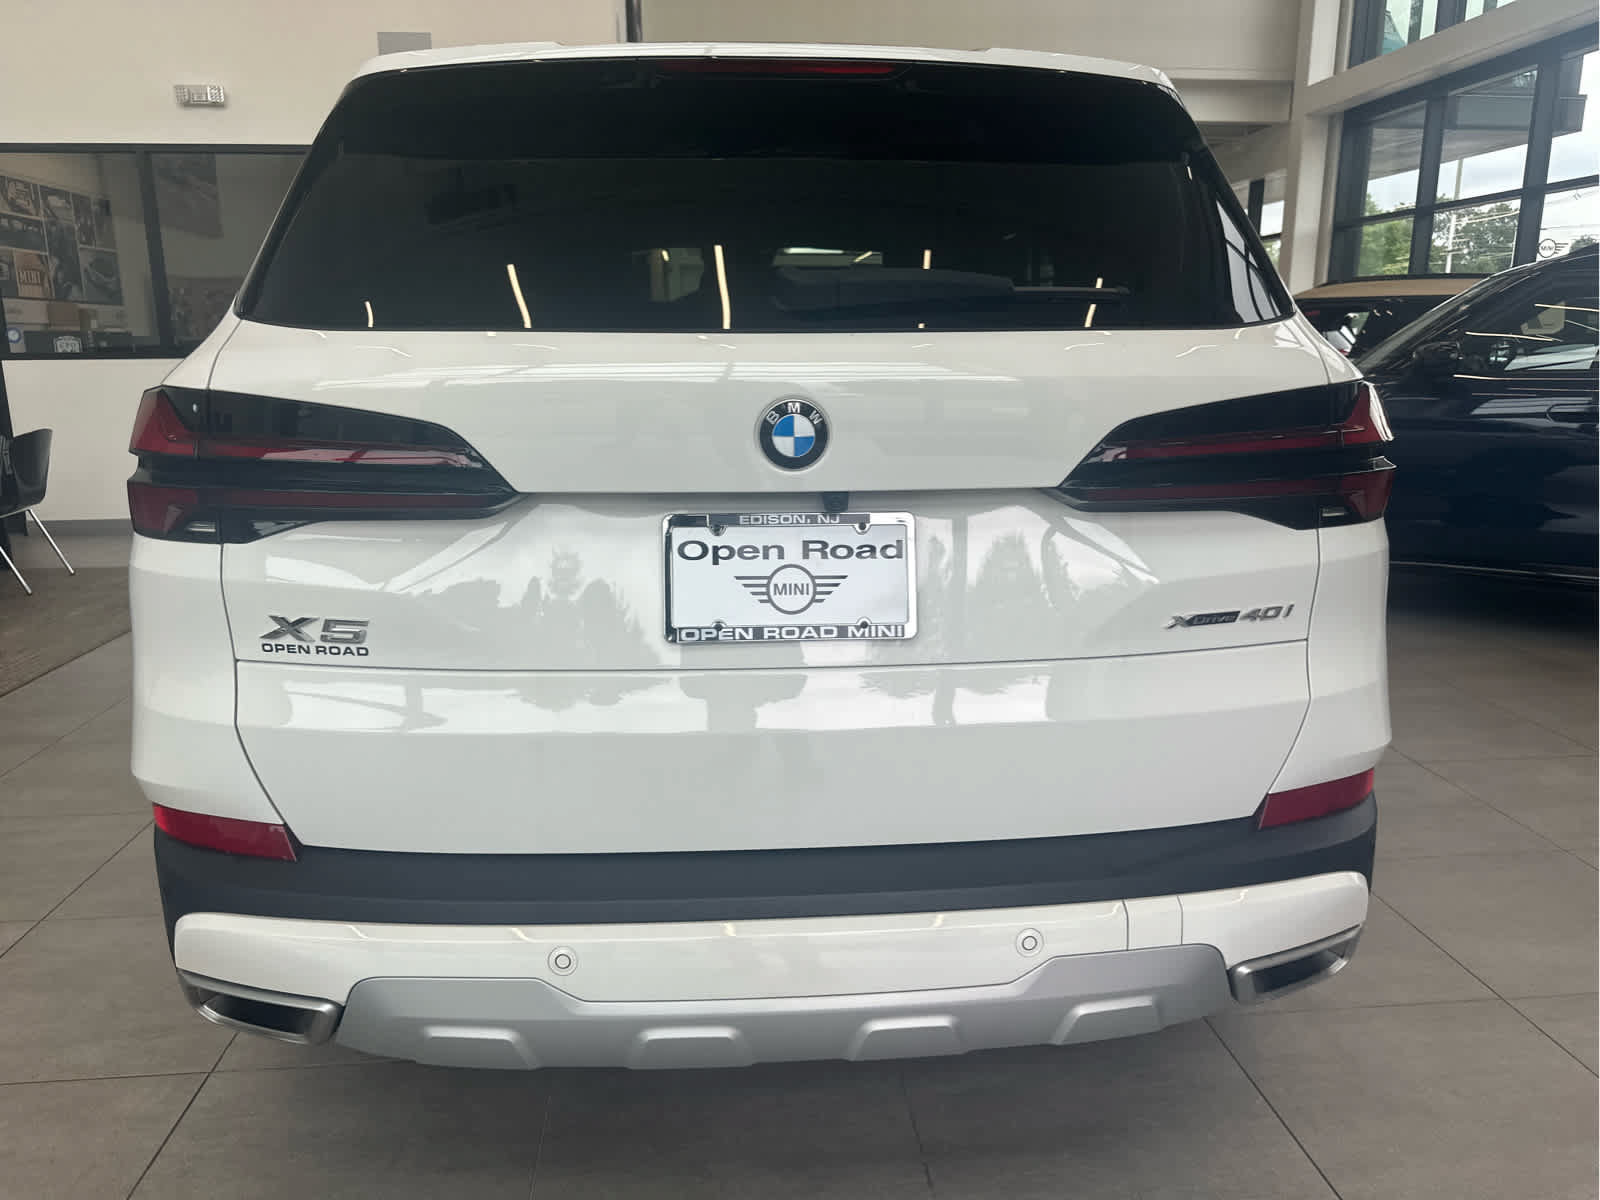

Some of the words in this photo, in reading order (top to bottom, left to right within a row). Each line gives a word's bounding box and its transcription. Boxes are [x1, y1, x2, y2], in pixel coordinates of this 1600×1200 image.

[766, 402, 823, 424] BMW
[740, 514, 811, 525] EDISON,
[817, 514, 840, 524] NJ
[677, 540, 784, 565] Open
[802, 539, 904, 560] Road
[773, 583, 810, 595] MINI
[260, 615, 370, 644] X5
[681, 627, 754, 641] OPEN
[763, 627, 837, 640] ROAD
[847, 626, 904, 638] MINI
[261, 643, 311, 654] OPEN
[315, 645, 369, 657] ROAD
